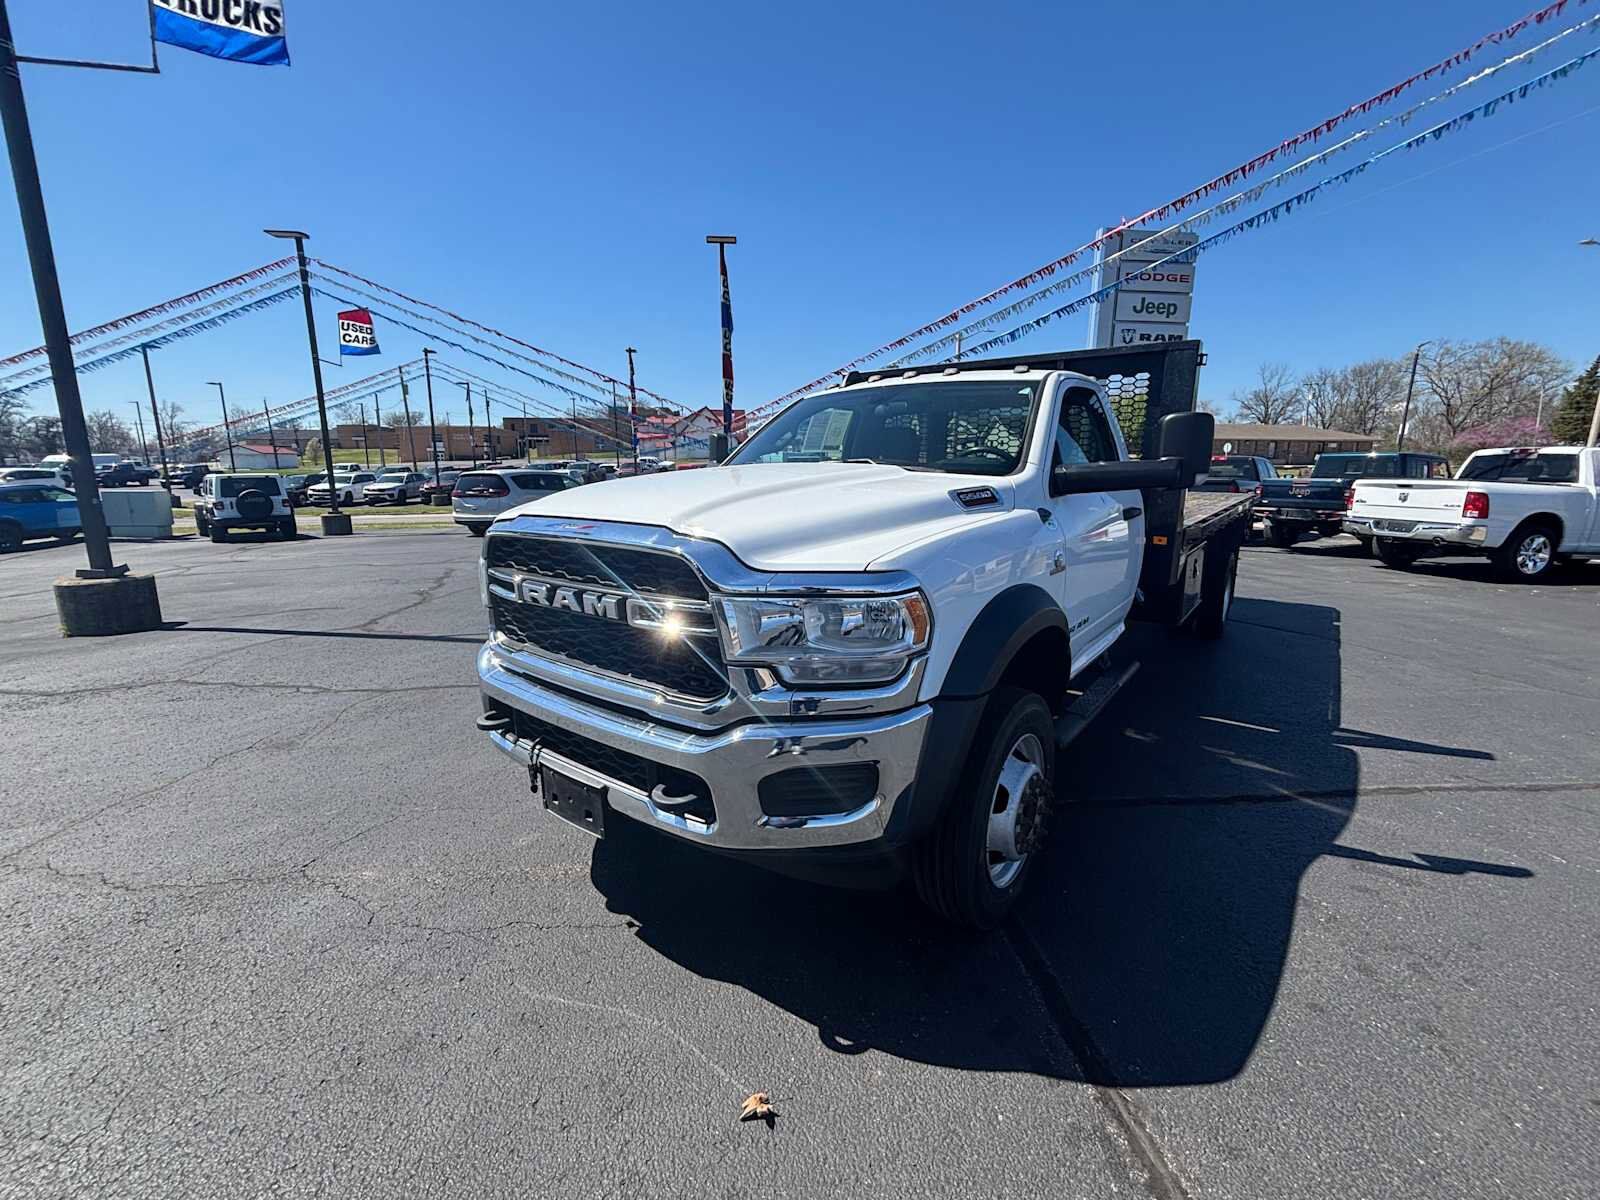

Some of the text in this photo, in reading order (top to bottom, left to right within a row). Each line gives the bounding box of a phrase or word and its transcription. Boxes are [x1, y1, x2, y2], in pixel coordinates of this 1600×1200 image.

[156, 0, 281, 35] RUCKS
[1132, 297, 1178, 318] Jeep
[341, 321, 373, 335] USED
[342, 333, 376, 345] CARS
[1139, 333, 1184, 342] RAM
[1288, 487, 1311, 497] Jeep
[522, 579, 624, 620] RAM
